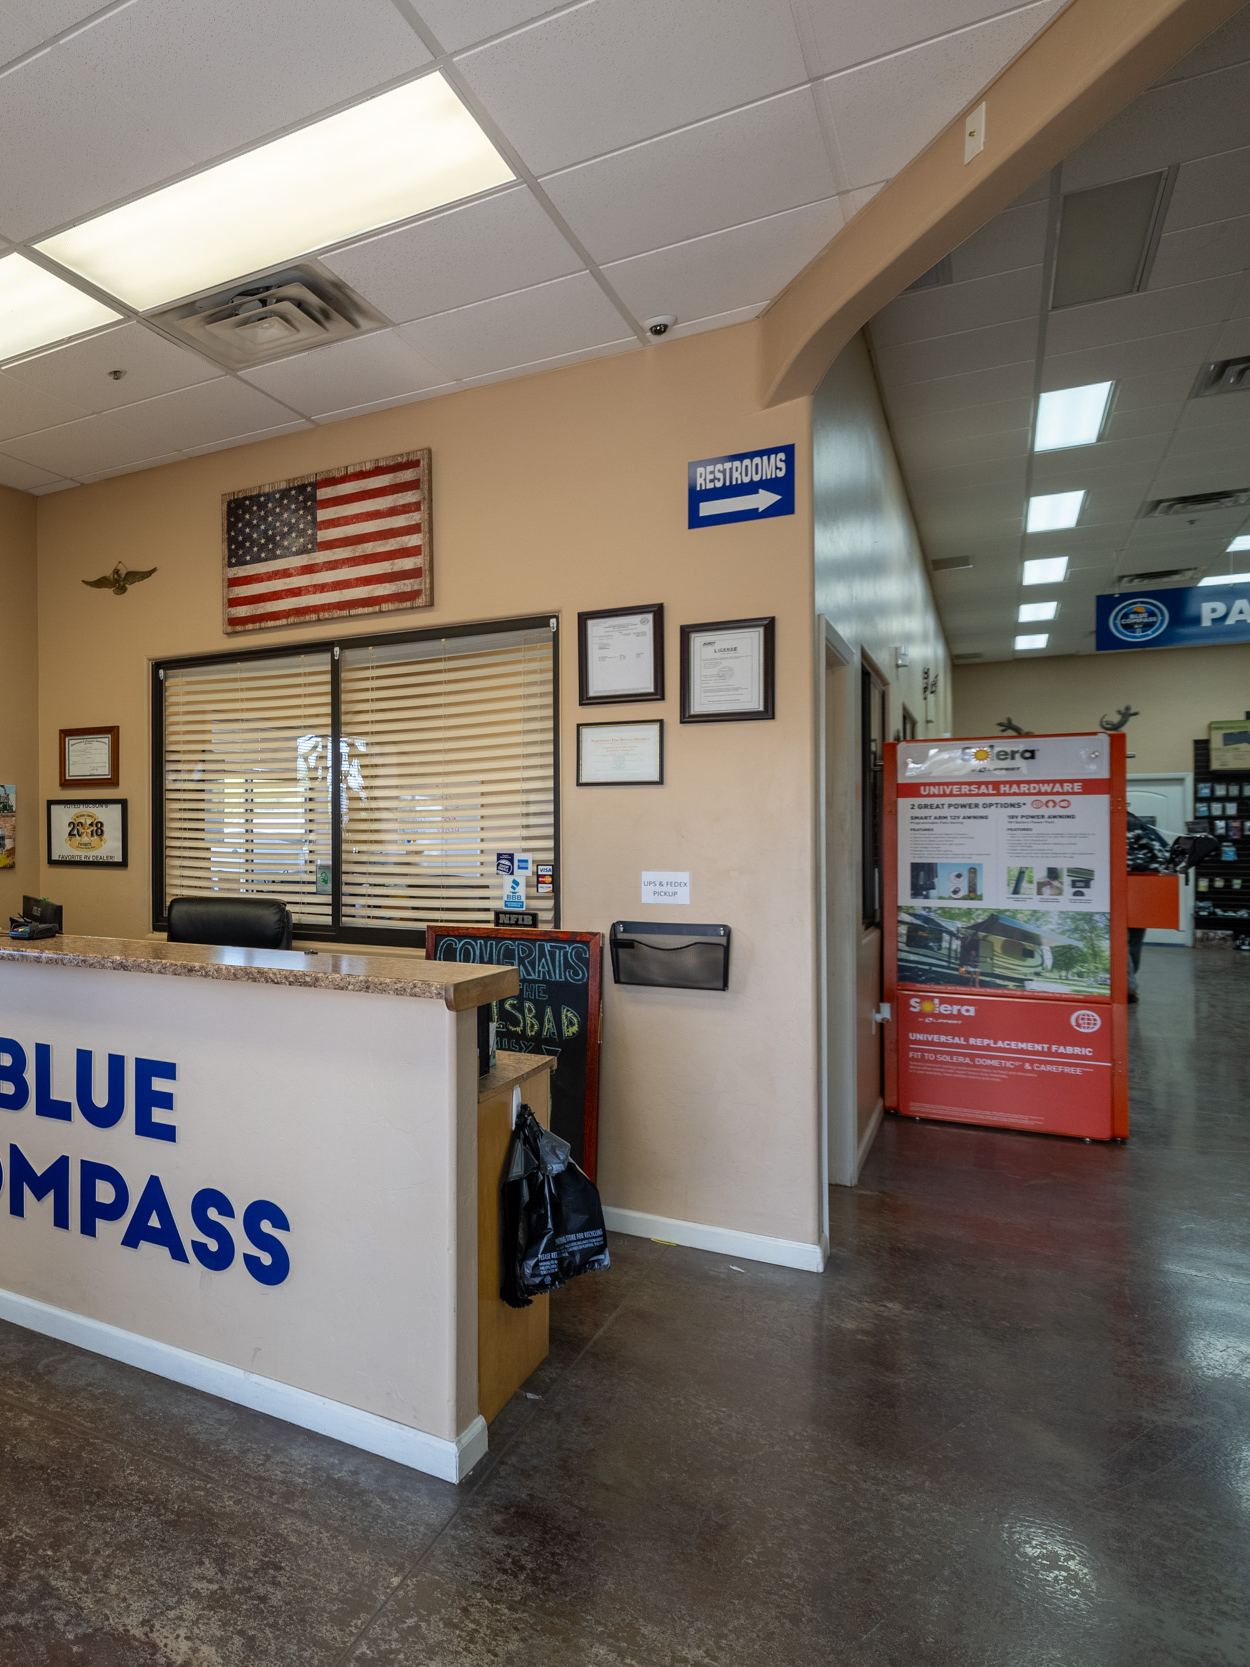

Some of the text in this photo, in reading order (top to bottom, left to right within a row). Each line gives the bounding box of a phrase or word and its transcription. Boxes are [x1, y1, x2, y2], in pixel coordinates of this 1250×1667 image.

[696, 452, 786, 491] RESTROOMS
[920, 782, 1083, 795] UNIVERSAL HARDWARE
[917, 802, 946, 810] GREAT
[947, 802, 980, 810] POWER
[68, 821, 105, 838] 2018
[499, 913, 533, 925] NFIB
[436, 937, 590, 984] CONGRATS
[519, 982, 549, 1000] HE
[909, 998, 976, 1016] Solera
[908, 1032, 1094, 1056] UNIVERSAL REPLACEMENT FABRIC
[908, 1051, 923, 1059] FIT
[923, 1052, 936, 1061] TO
[936, 1053, 974, 1065] SOLERA,
[1024, 1062, 1032, 1070] &
[539, 1252, 551, 1261] PLEASE
